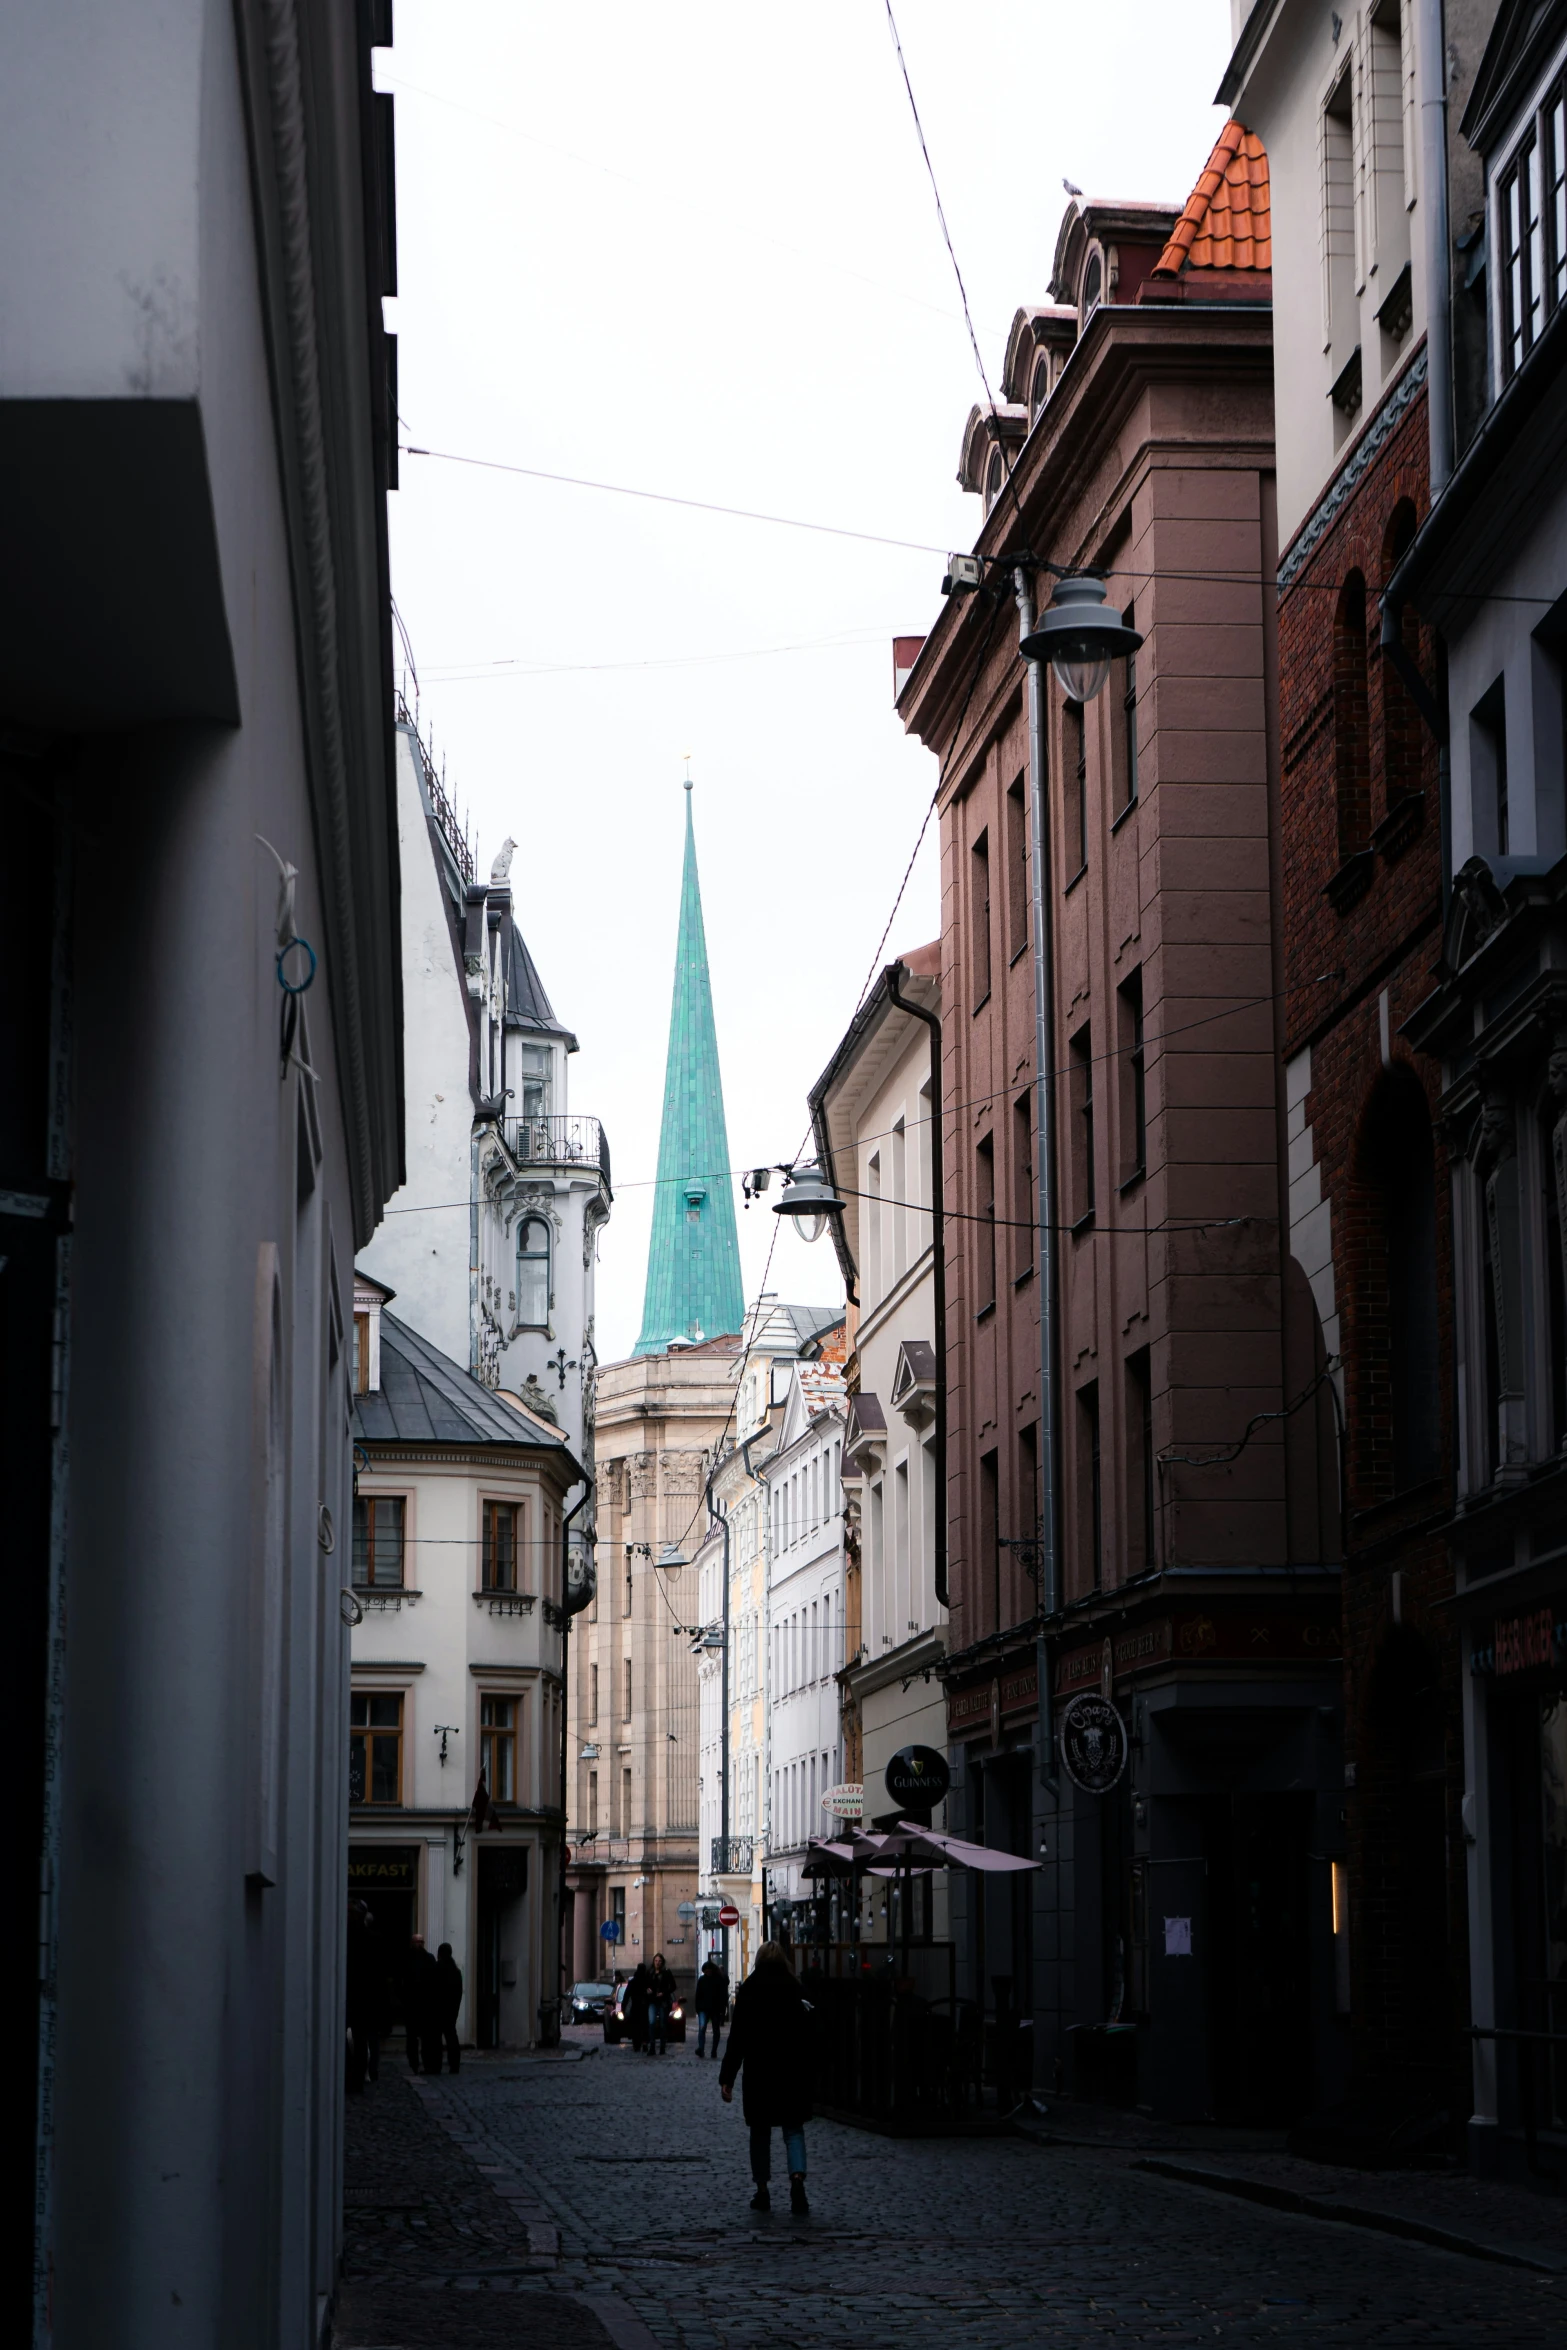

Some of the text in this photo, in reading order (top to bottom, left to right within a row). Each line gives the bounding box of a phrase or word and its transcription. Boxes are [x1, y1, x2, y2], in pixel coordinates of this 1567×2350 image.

[1120, 1632, 1154, 1662] GOOD BEER
[1494, 1607, 1554, 1677] HESBURGER
[893, 1775, 943, 1788] GUINNESS
